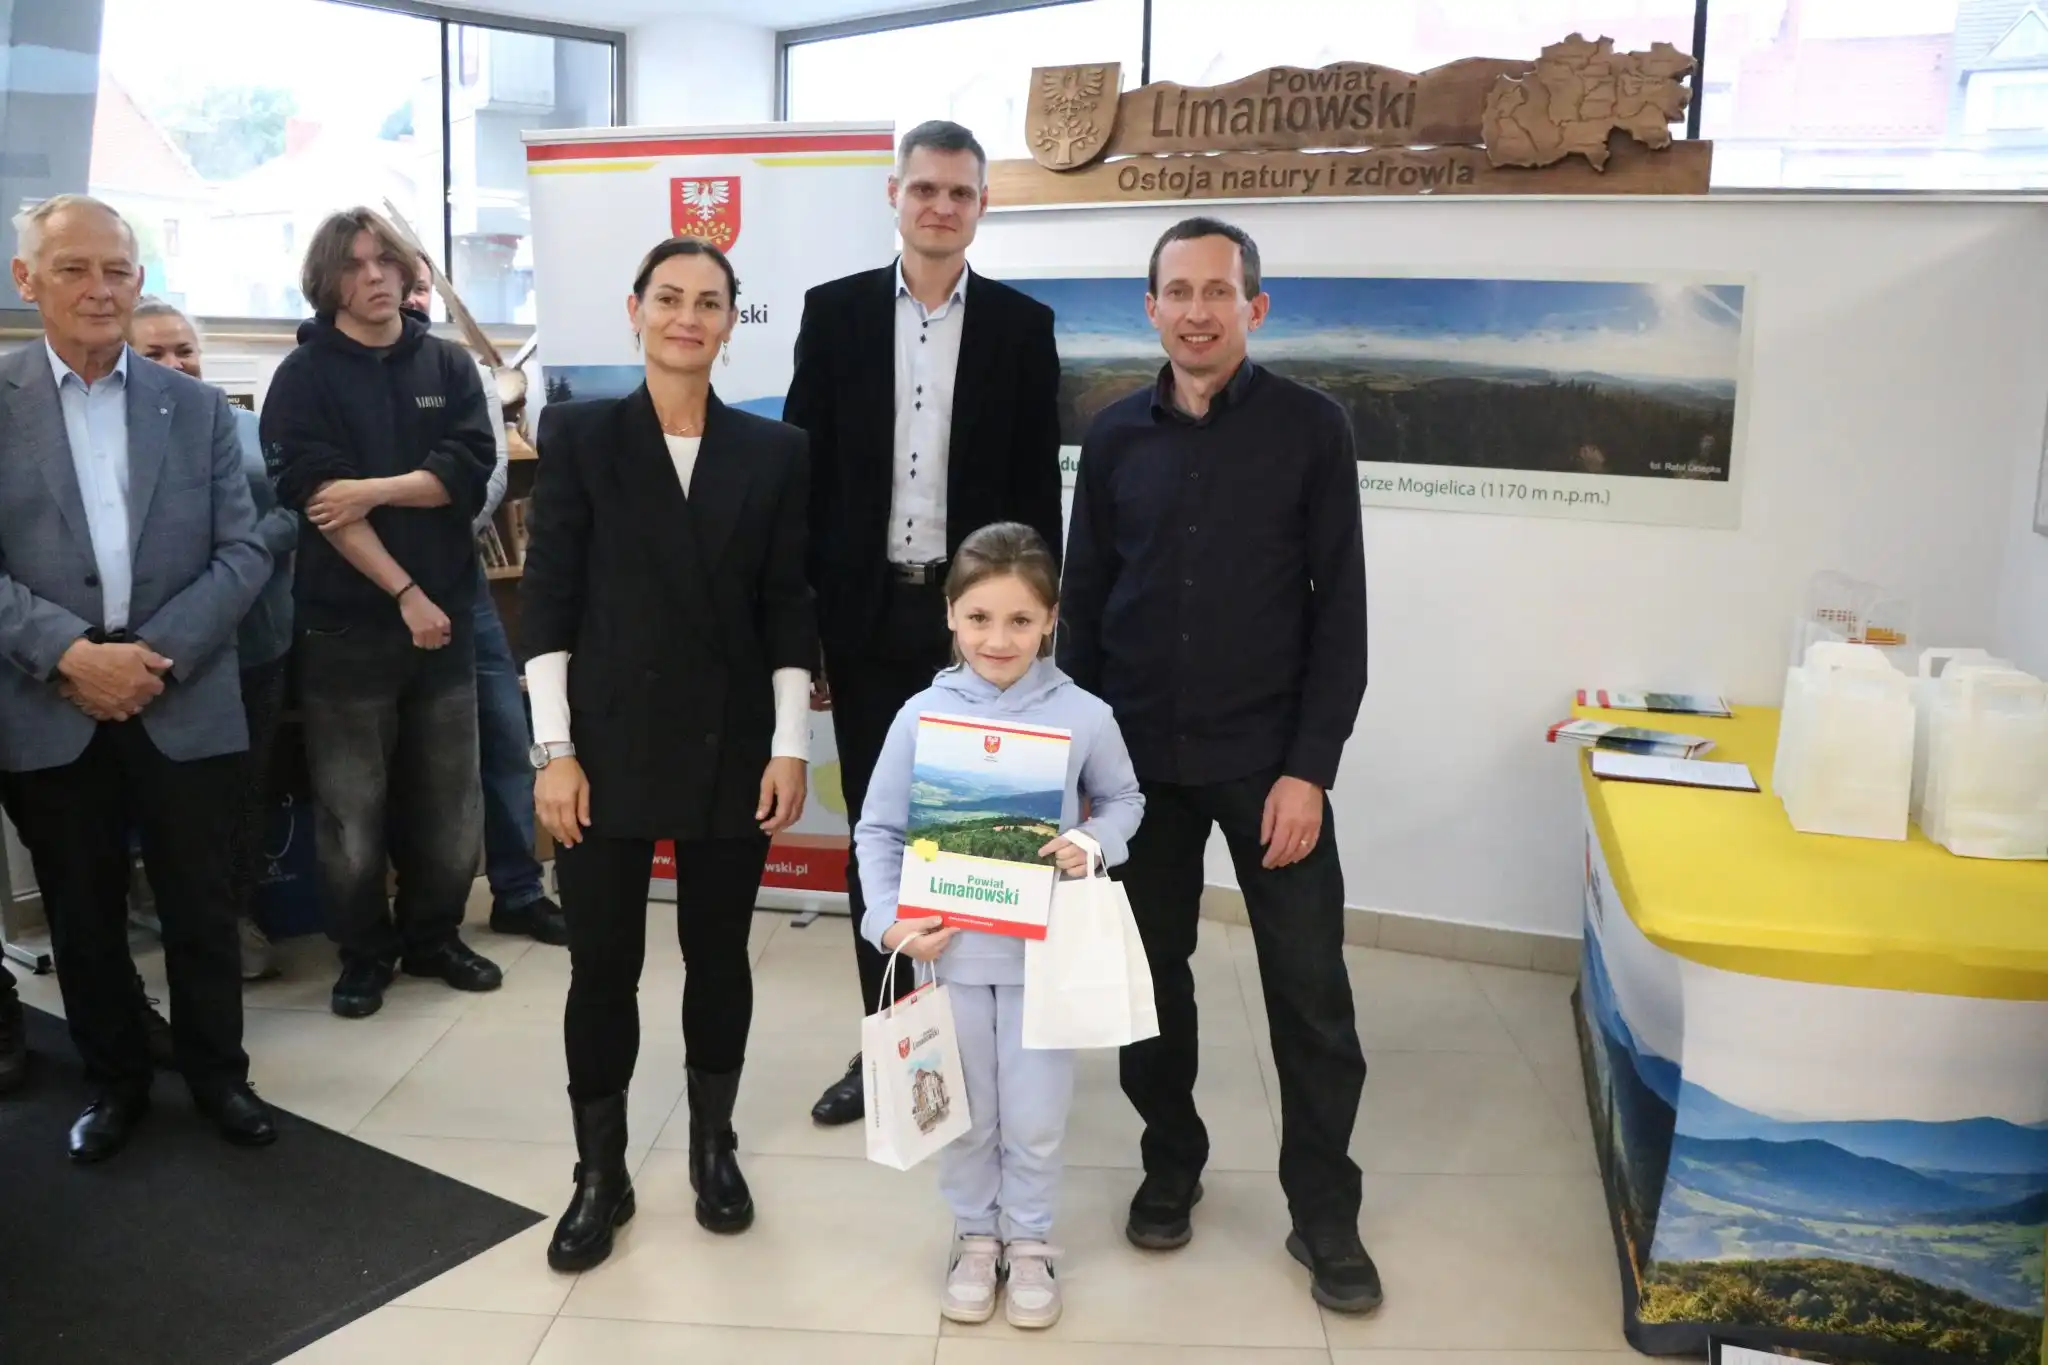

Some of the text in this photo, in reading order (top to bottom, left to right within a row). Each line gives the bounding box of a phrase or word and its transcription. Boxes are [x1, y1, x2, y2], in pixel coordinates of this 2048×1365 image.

[1267, 67, 1378, 95] Powiat
[1152, 80, 1417, 138] Limanowski
[1118, 164, 1212, 198] Ostoja
[1222, 164, 1320, 194] natury
[1329, 162, 1337, 186] i
[1360, 475, 1610, 506] órze Mogielica (1170 m n.p.m.)
[930, 876, 1020, 905] Limanowski
[967, 875, 1004, 889] Powiat
